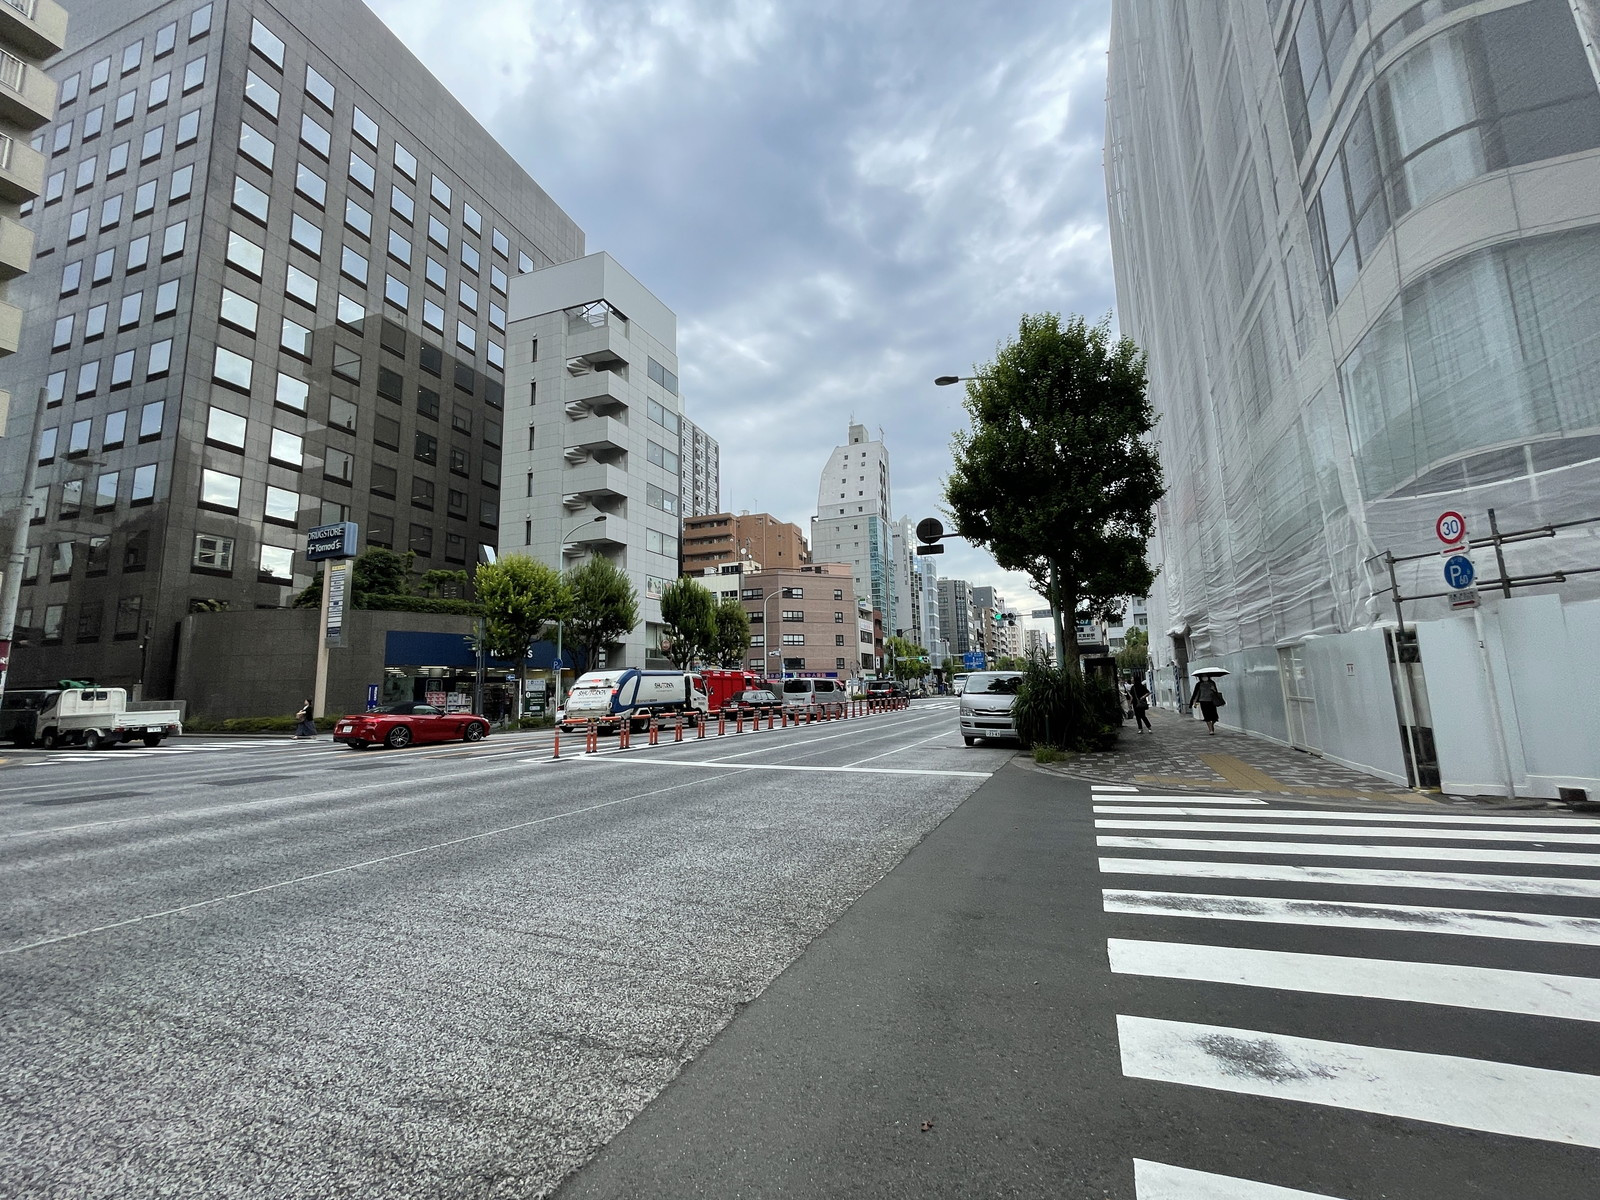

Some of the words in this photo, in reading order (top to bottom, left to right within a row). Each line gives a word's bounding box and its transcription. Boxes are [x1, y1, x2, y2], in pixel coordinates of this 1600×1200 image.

[307, 526, 345, 541] DRUGSTORE
[1442, 520, 1459, 536] 30
[315, 538, 342, 553] Tomod's
[1450, 565, 1461, 586] P
[1460, 575, 1468, 584] 60
